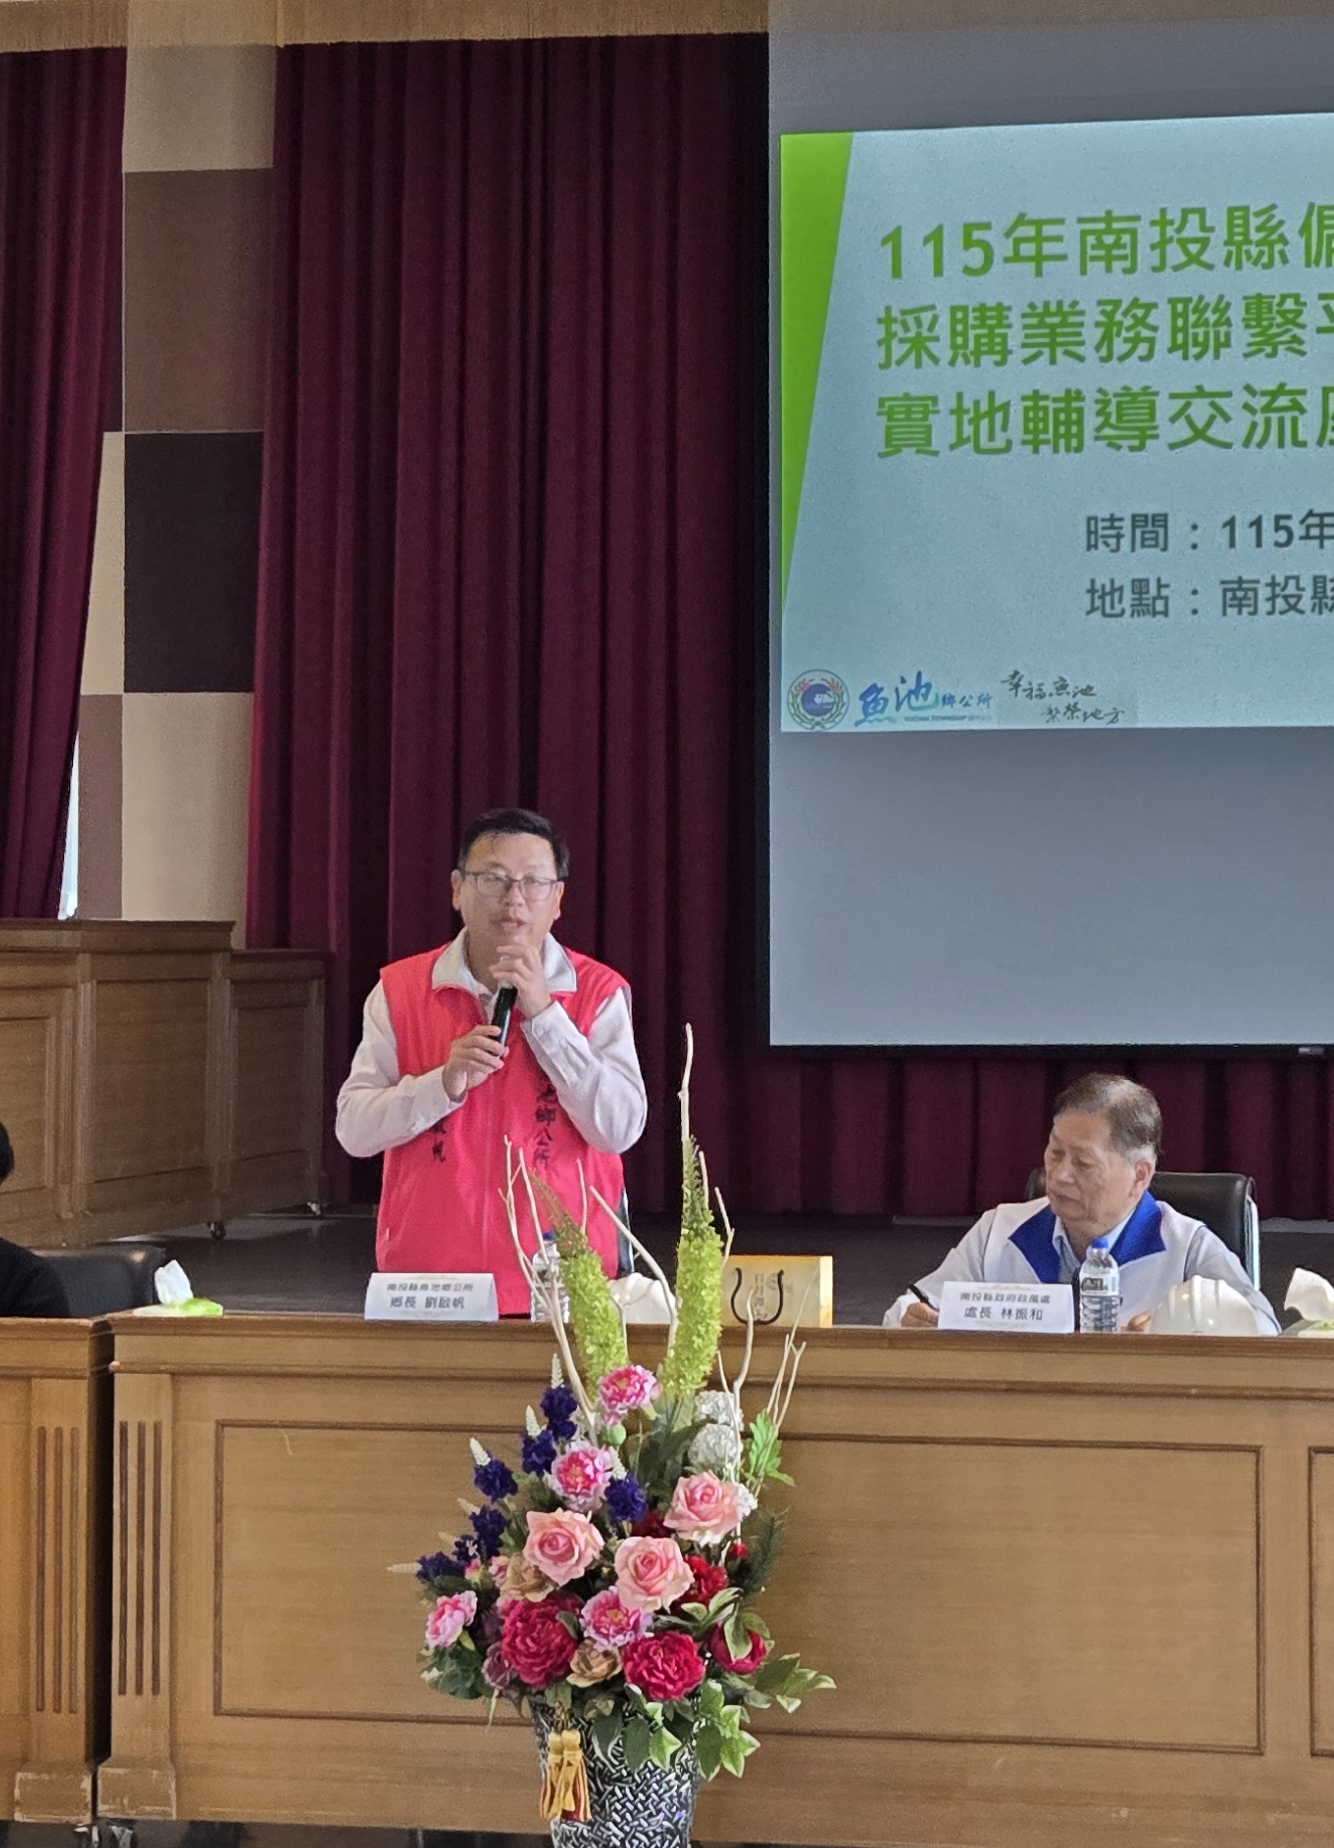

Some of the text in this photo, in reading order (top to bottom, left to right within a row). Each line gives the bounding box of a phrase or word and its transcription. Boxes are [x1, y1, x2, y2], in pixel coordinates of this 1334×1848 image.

[387, 1282, 473, 1292] 南投縣魚池鄉公所
[390, 1296, 416, 1309] 鄉長
[960, 1291, 1051, 1304] 南投縣政府政風處
[964, 1306, 1043, 1321] 處長 林振和
